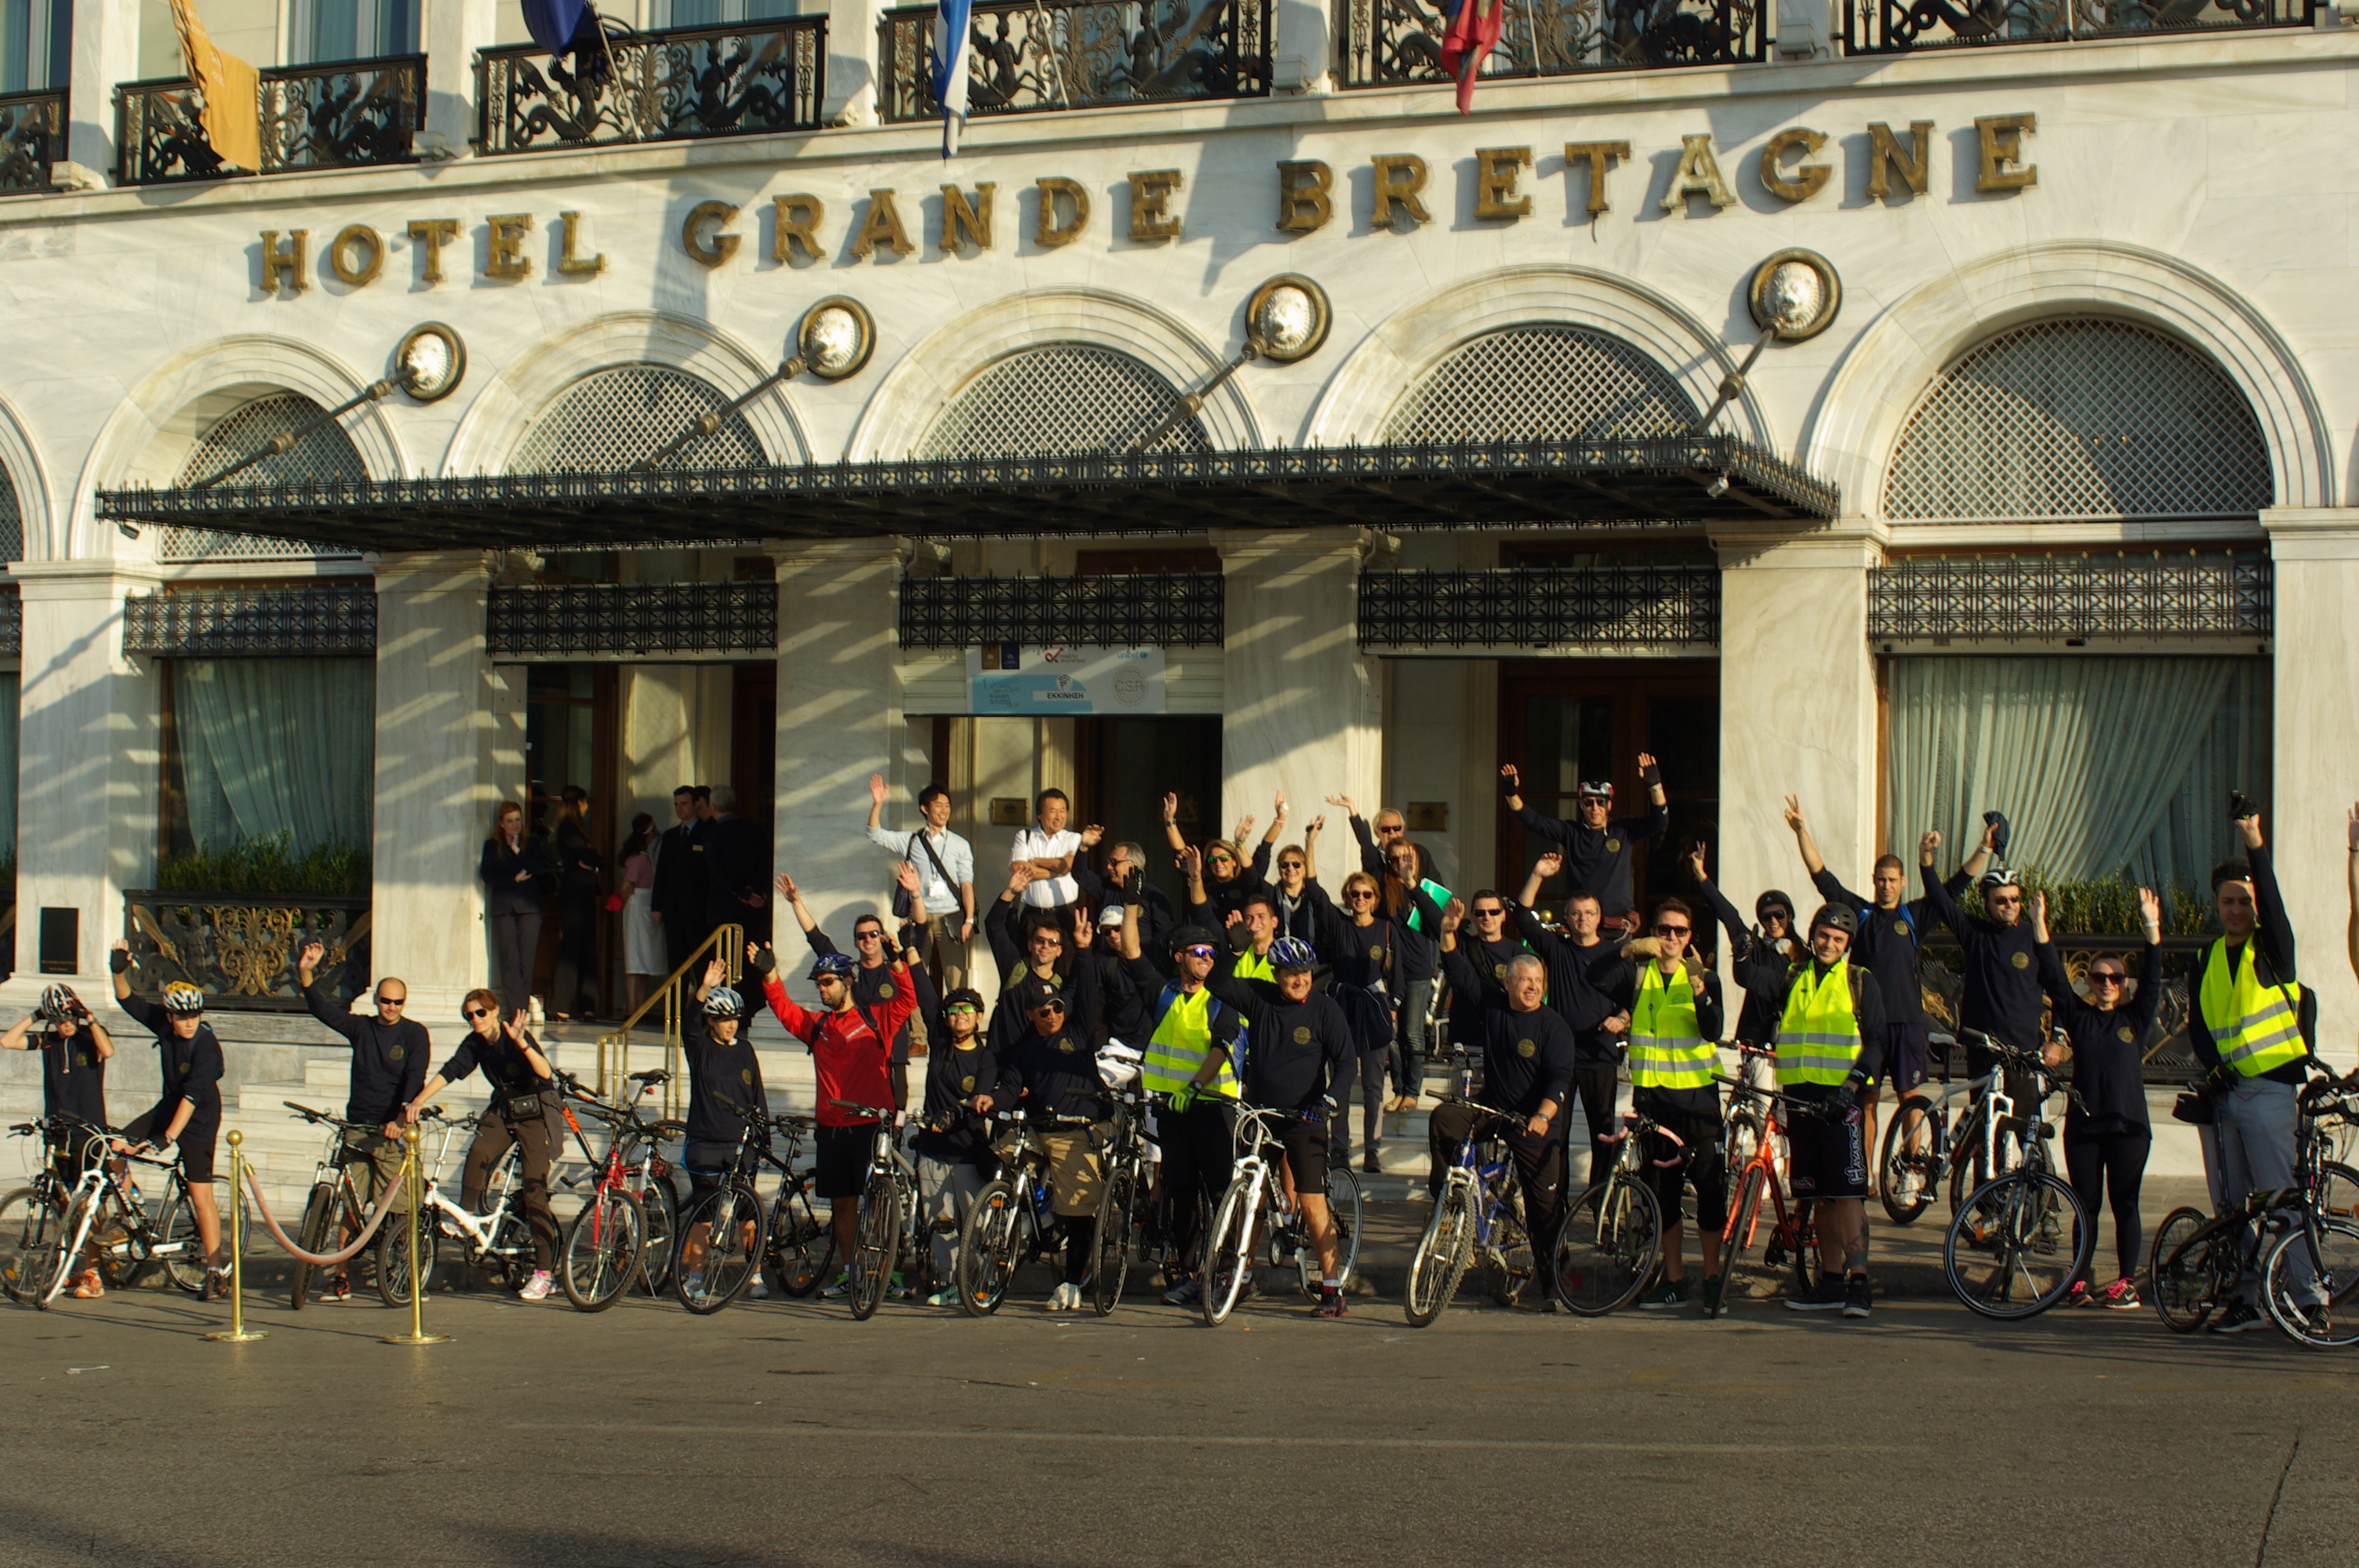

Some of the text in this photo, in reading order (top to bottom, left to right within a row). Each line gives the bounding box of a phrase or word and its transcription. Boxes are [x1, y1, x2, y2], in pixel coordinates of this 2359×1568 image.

[260, 111, 2039, 292] HOTEL GRANDE BRETAGNE
[1117, 651, 1139, 659] unicef
[1845, 1122, 1865, 1183] HAYABUSA
